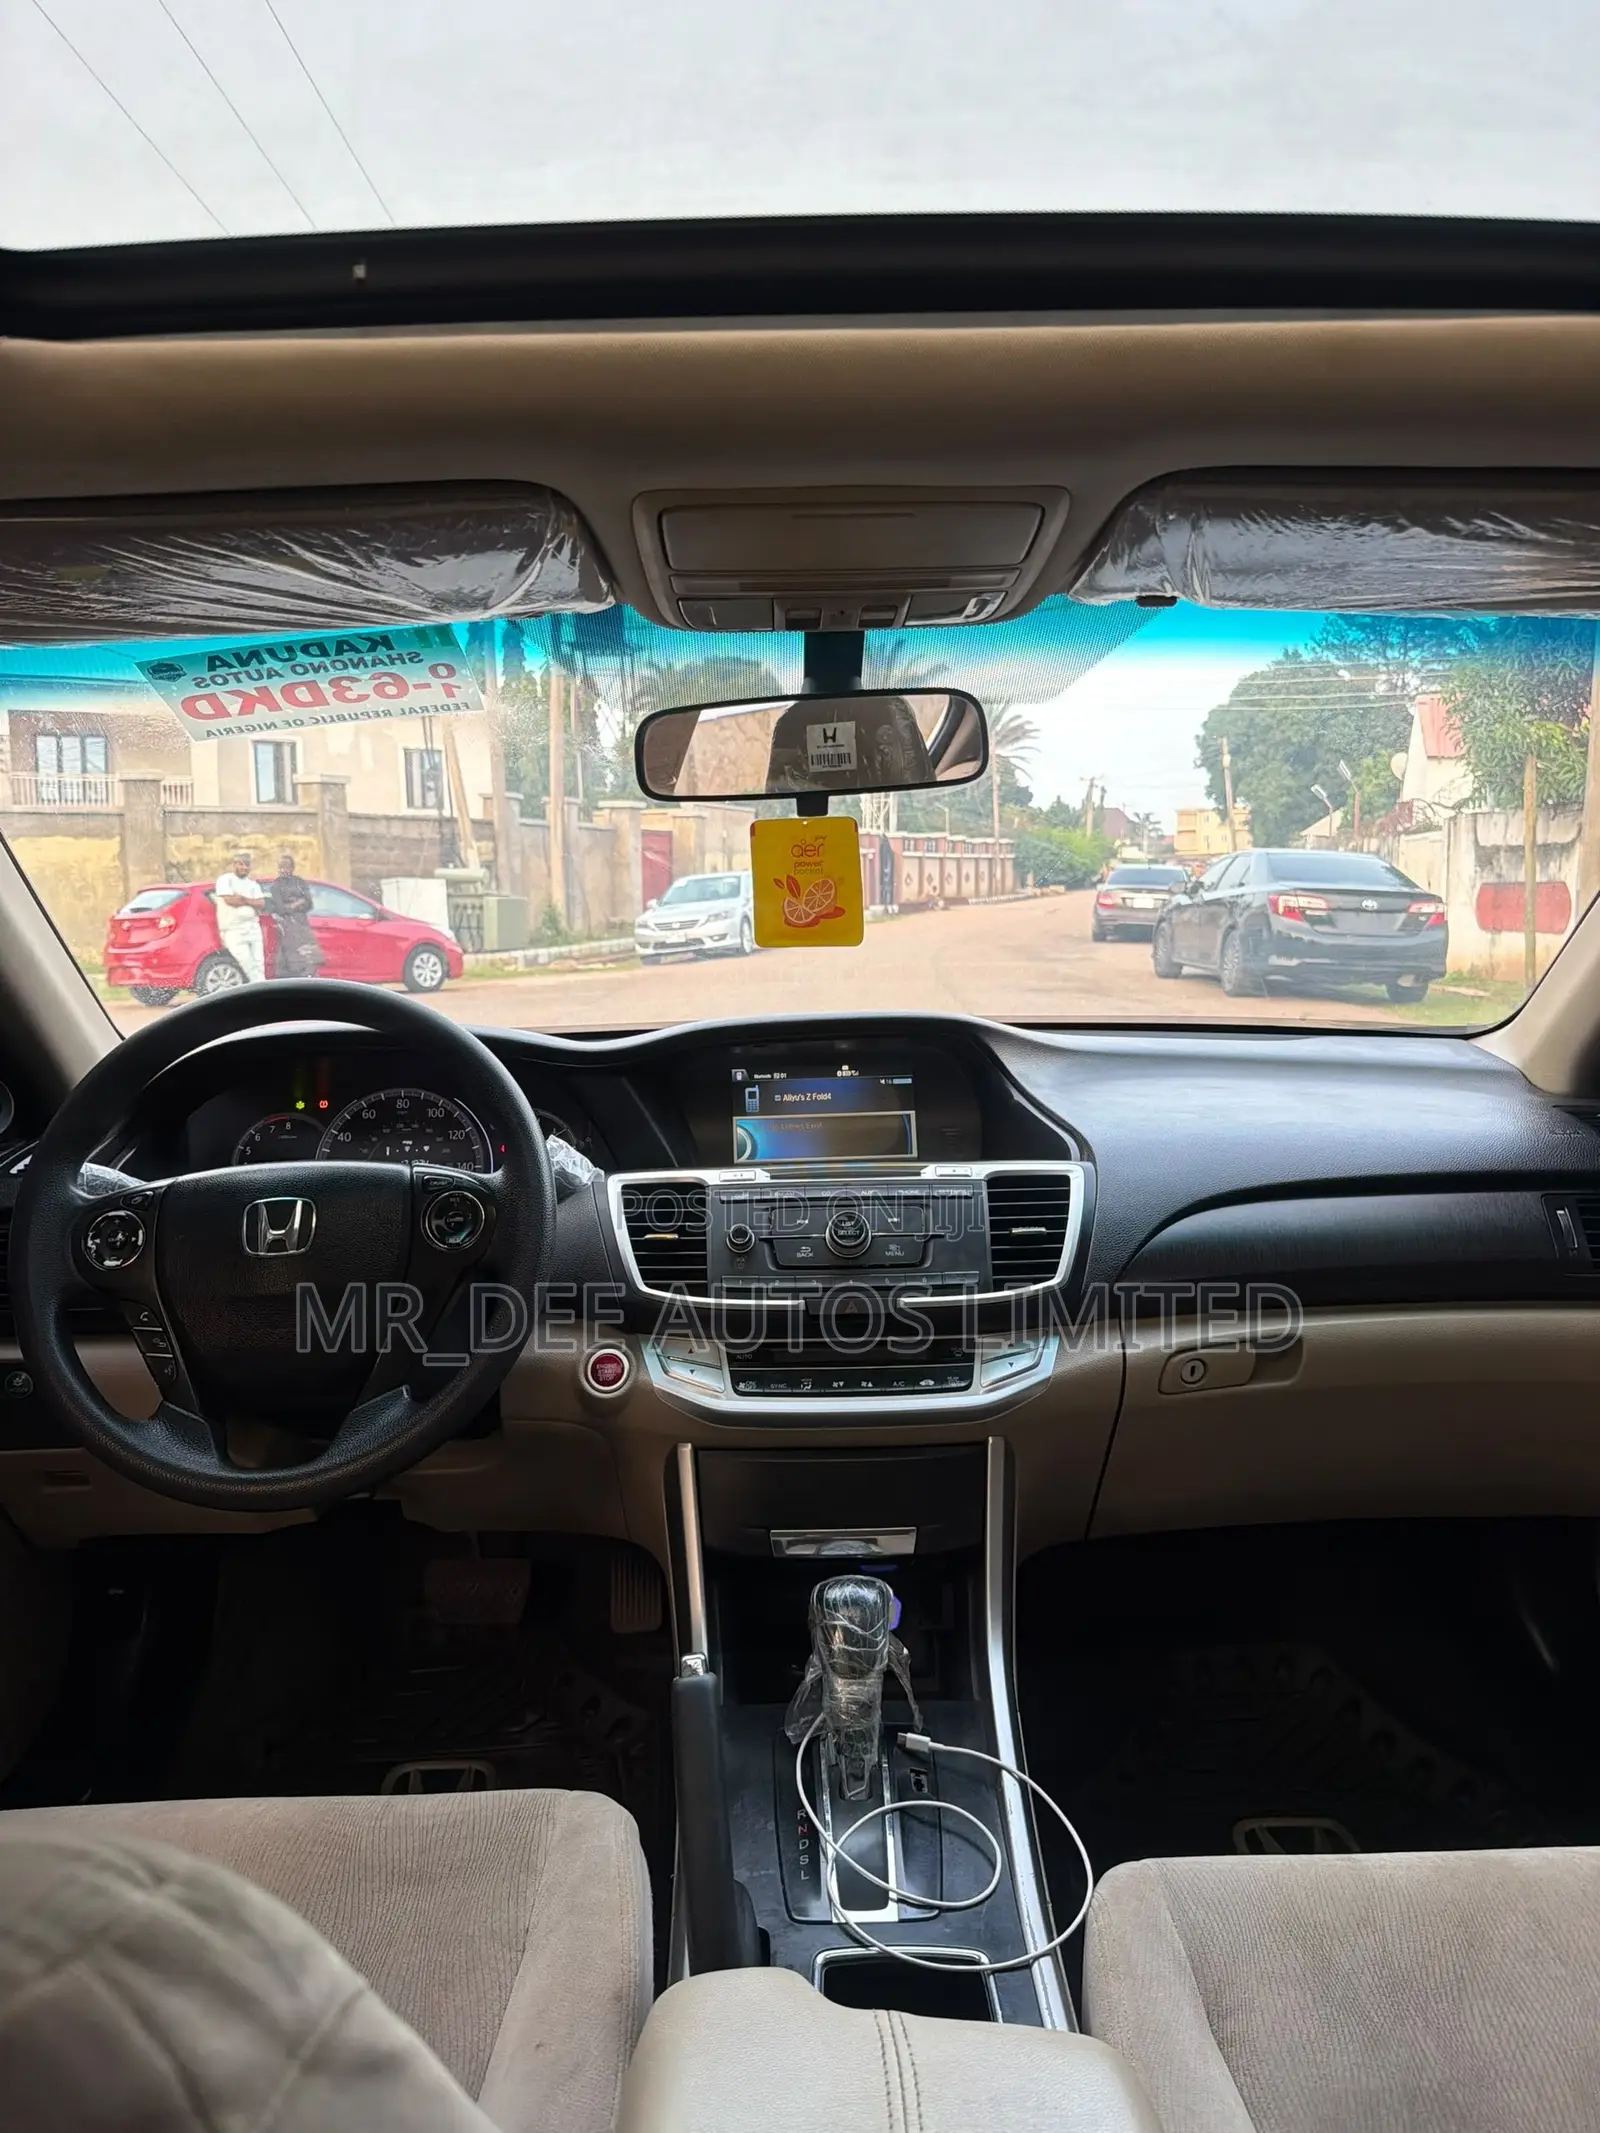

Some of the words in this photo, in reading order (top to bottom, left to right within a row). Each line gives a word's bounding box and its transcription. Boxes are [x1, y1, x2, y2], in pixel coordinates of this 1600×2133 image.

[793, 860, 824, 871] power
[396, 1098, 410, 1109] 80
[362, 1109, 376, 1120] 60
[427, 1107, 445, 1118] 100
[269, 1125, 276, 1134] 7
[285, 1122, 292, 1131] 8
[254, 1132, 261, 1142] 6
[337, 1131, 352, 1142] 40
[448, 1129, 466, 1140] 120
[245, 1147, 252, 1156] 5
[457, 1161, 474, 1171] 140
[797, 1809, 806, 1820] R
[797, 1825, 808, 1836] N
[799, 1839, 809, 1850] D
[799, 1854, 810, 1865] S
[801, 1870, 810, 1880] L
